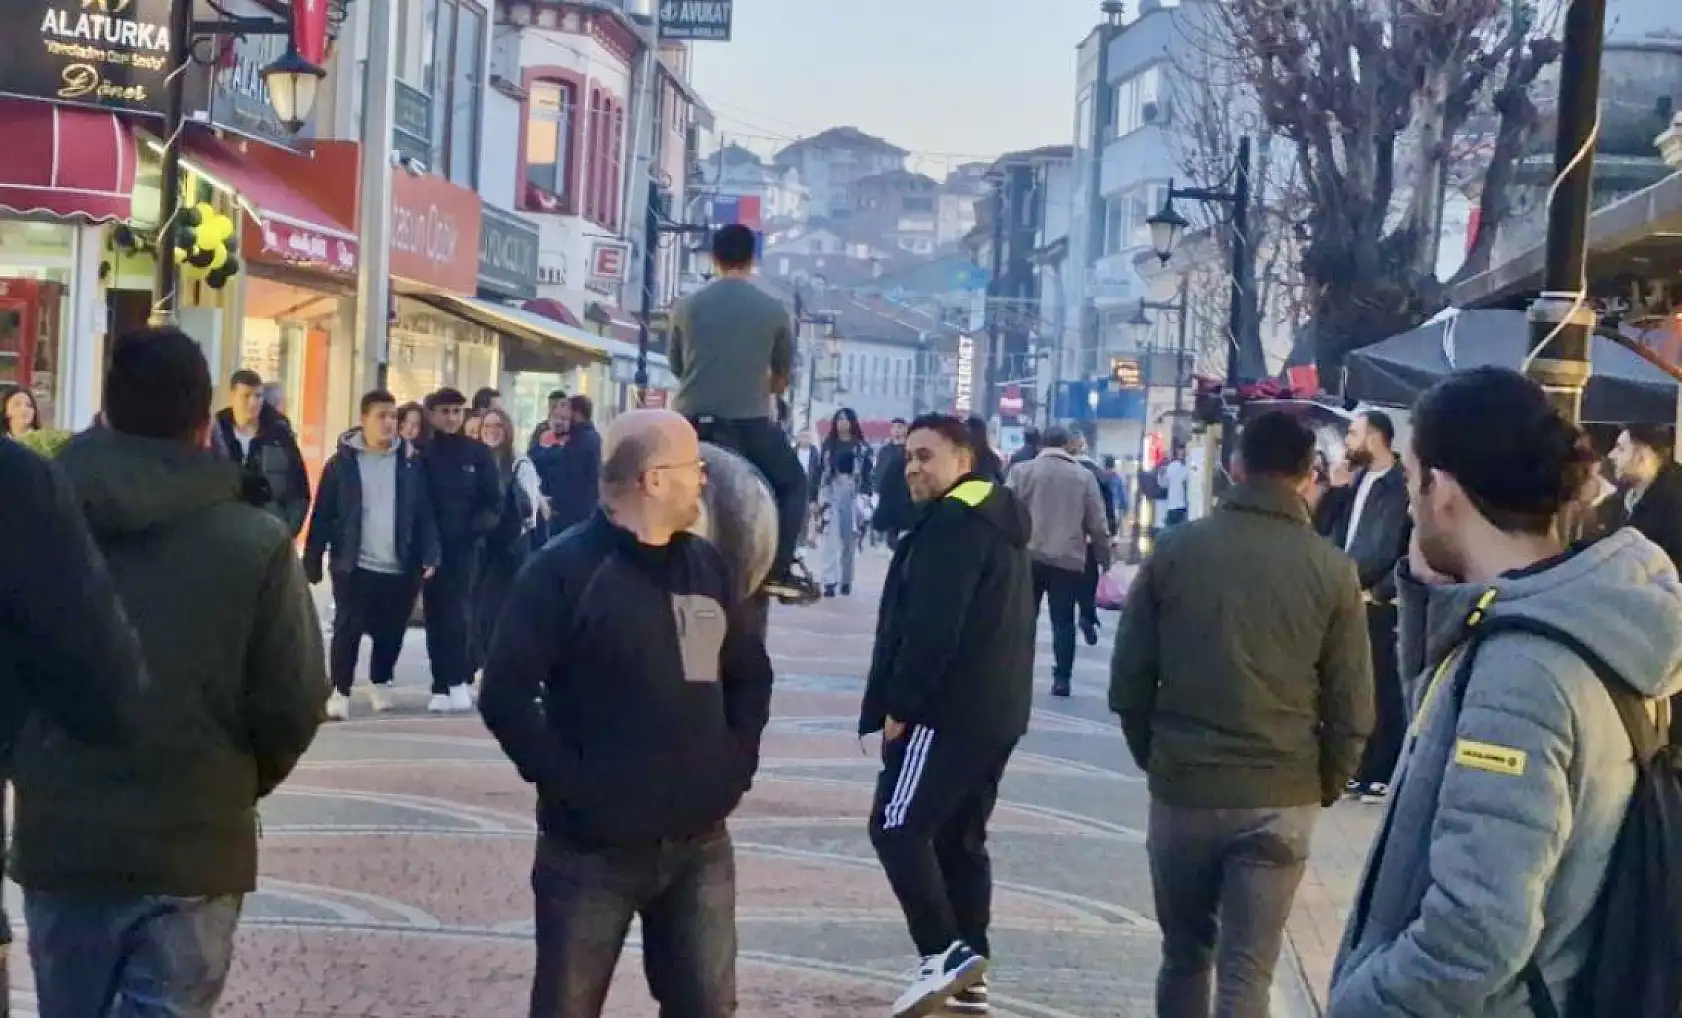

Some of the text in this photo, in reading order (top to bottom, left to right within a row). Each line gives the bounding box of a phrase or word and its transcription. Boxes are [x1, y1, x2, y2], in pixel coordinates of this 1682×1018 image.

[680, 2, 729, 24] AVUKAT
[40, 8, 171, 53] ALATURKA
[598, 248, 620, 274] E
